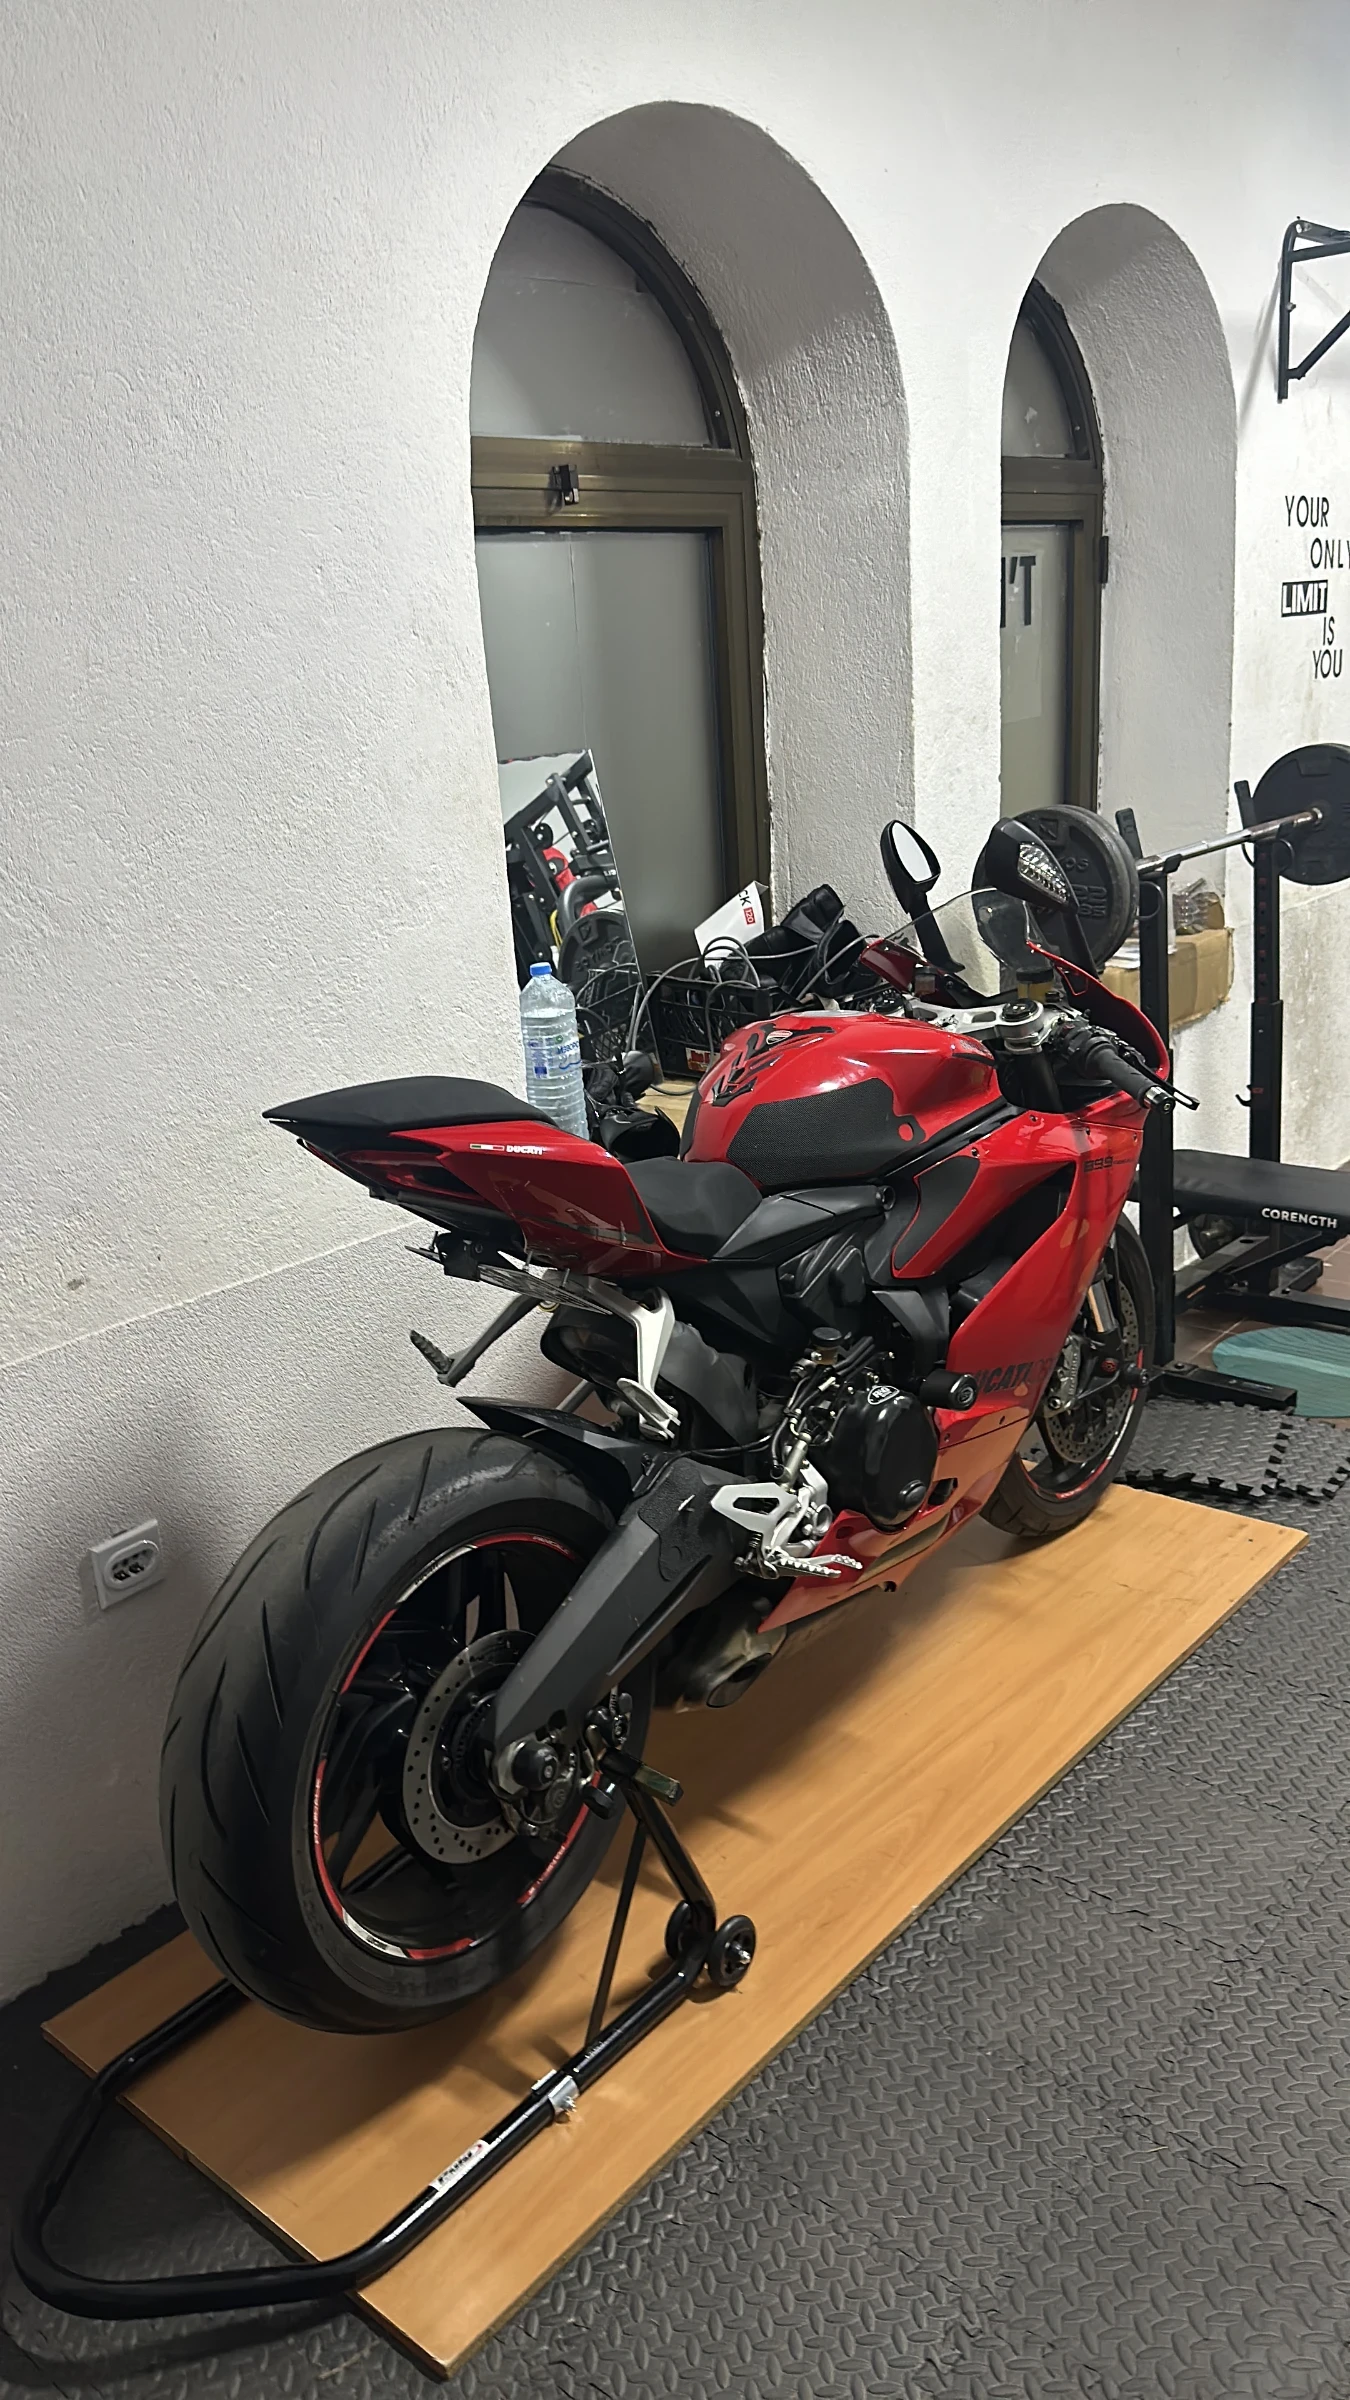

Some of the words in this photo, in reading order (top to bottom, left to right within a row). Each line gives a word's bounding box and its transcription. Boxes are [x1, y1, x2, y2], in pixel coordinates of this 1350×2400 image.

[1285, 495, 1330, 527] YOUR
[1282, 581, 1328, 615] LIMIT
[1322, 616, 1335, 646] IS
[1313, 649, 1343, 679] YOU
[506, 1145, 543, 1155] DUCATI
[1083, 1156, 1113, 1172] 899
[1261, 1207, 1338, 1229] CORENGTH
[974, 1362, 1034, 1394] UCATI
